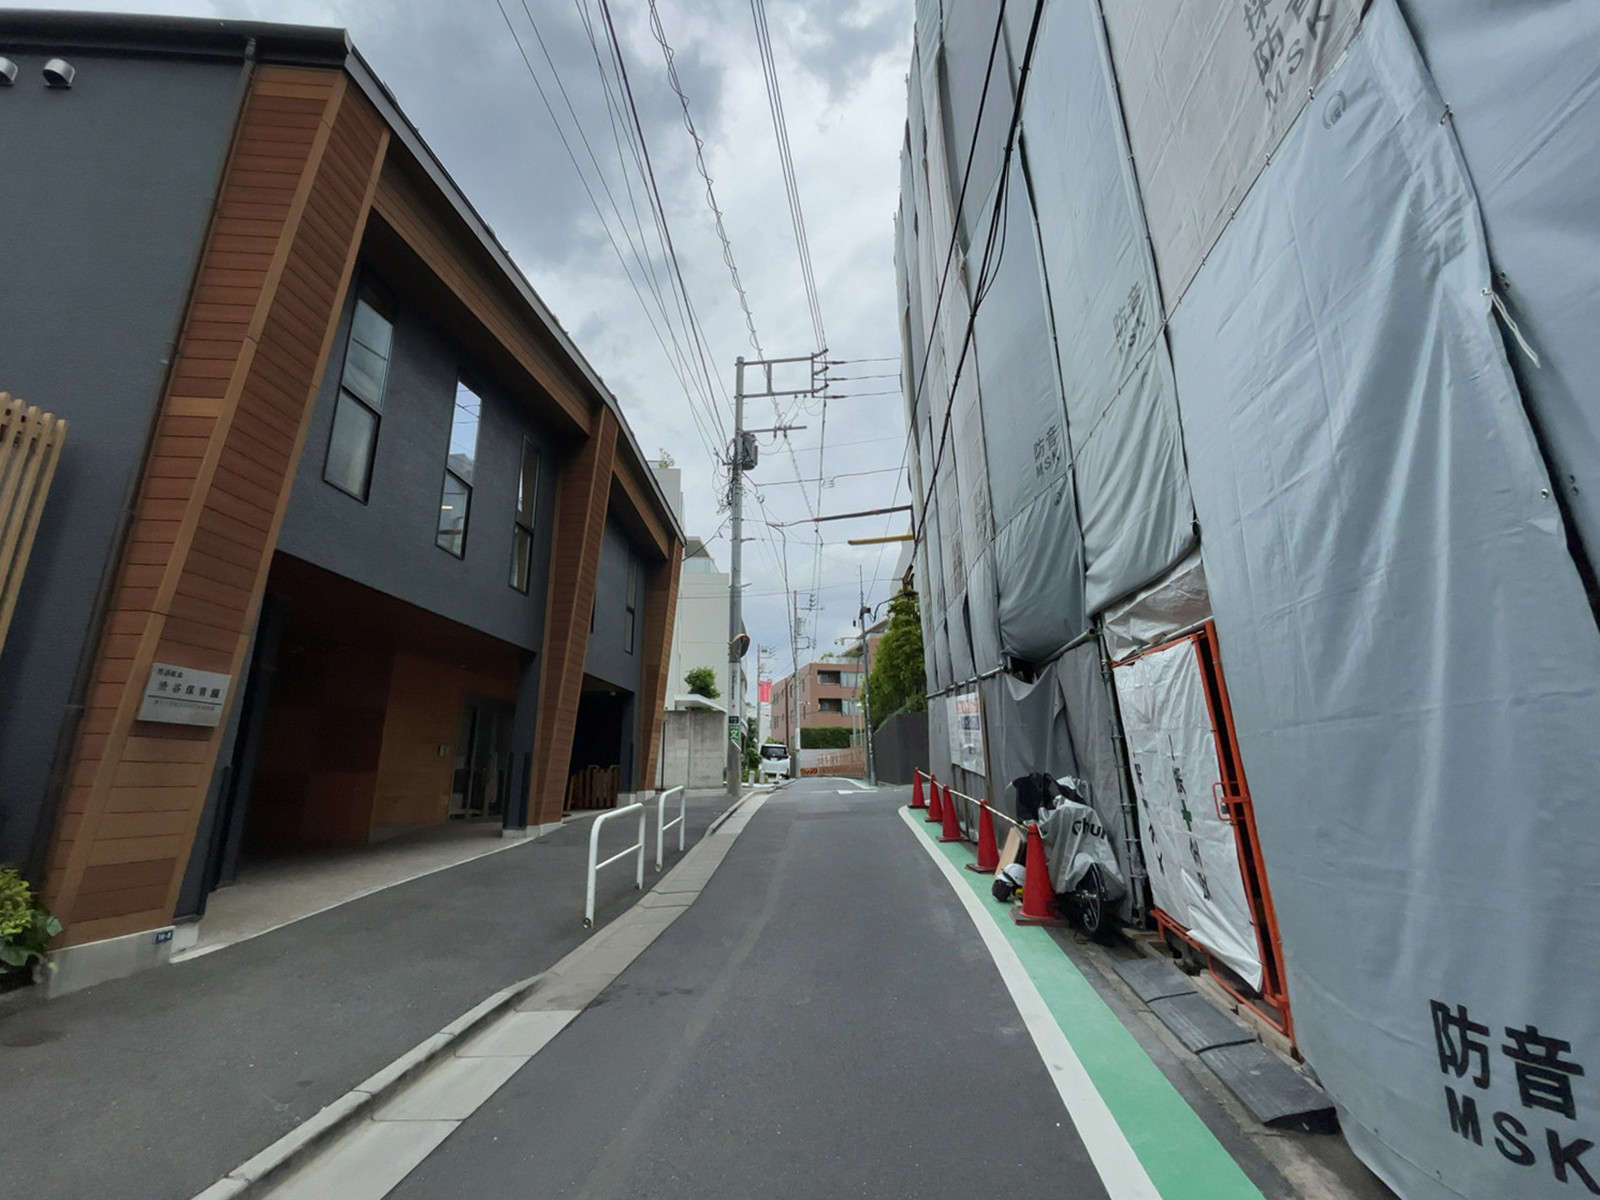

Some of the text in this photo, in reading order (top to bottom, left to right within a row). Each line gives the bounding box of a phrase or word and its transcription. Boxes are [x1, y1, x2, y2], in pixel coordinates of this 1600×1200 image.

[158, 680, 221, 699] 渋谷保育園
[1429, 998, 1585, 1120] 防音
[1444, 1085, 1600, 1196] MSK
